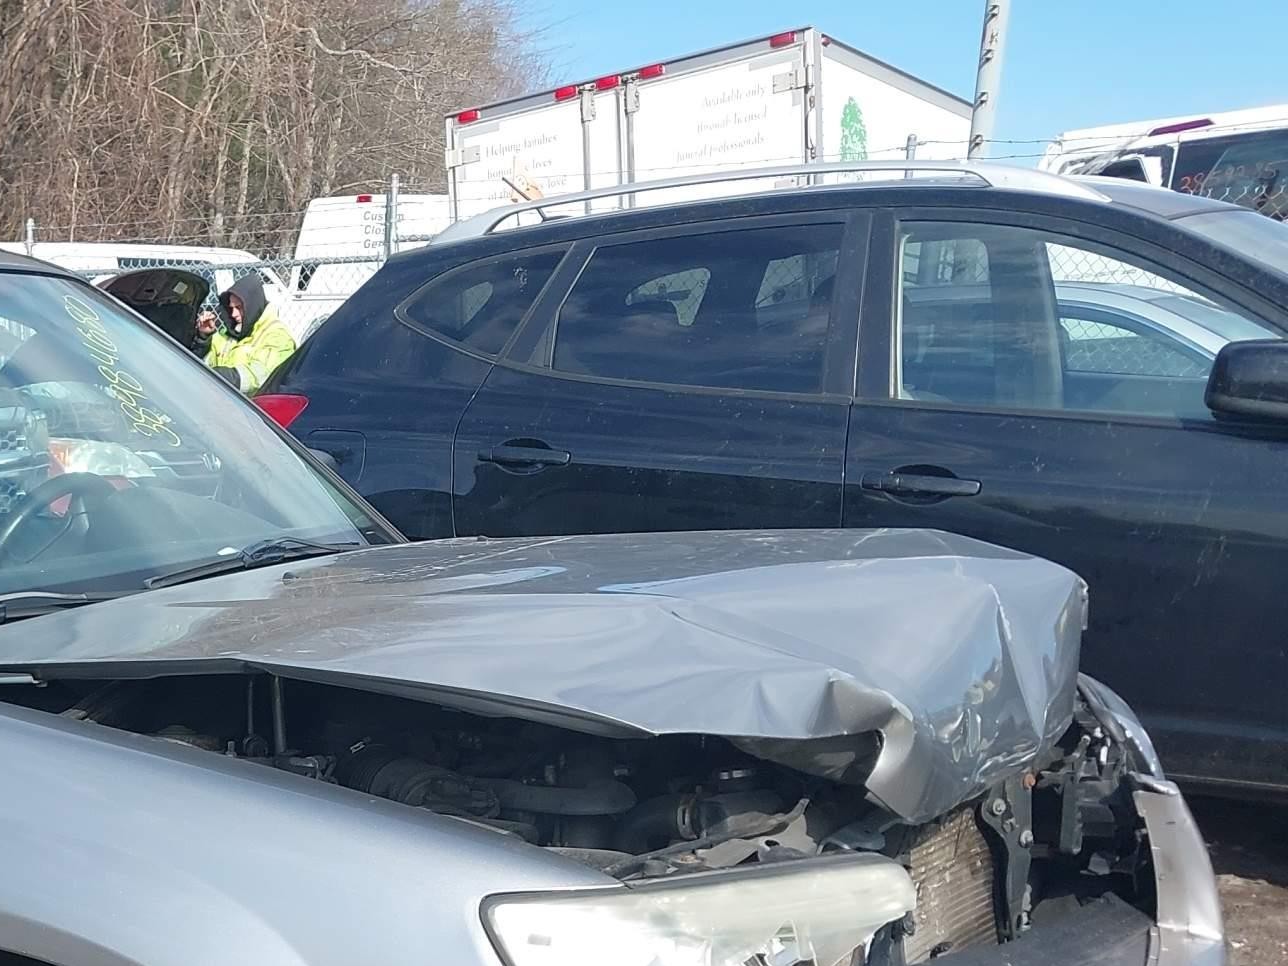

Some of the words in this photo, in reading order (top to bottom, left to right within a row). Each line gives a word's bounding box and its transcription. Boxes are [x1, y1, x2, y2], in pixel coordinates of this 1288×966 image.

[486, 143, 521, 157] Helping
[524, 133, 557, 148] families
[63, 294, 181, 447] 38984680
